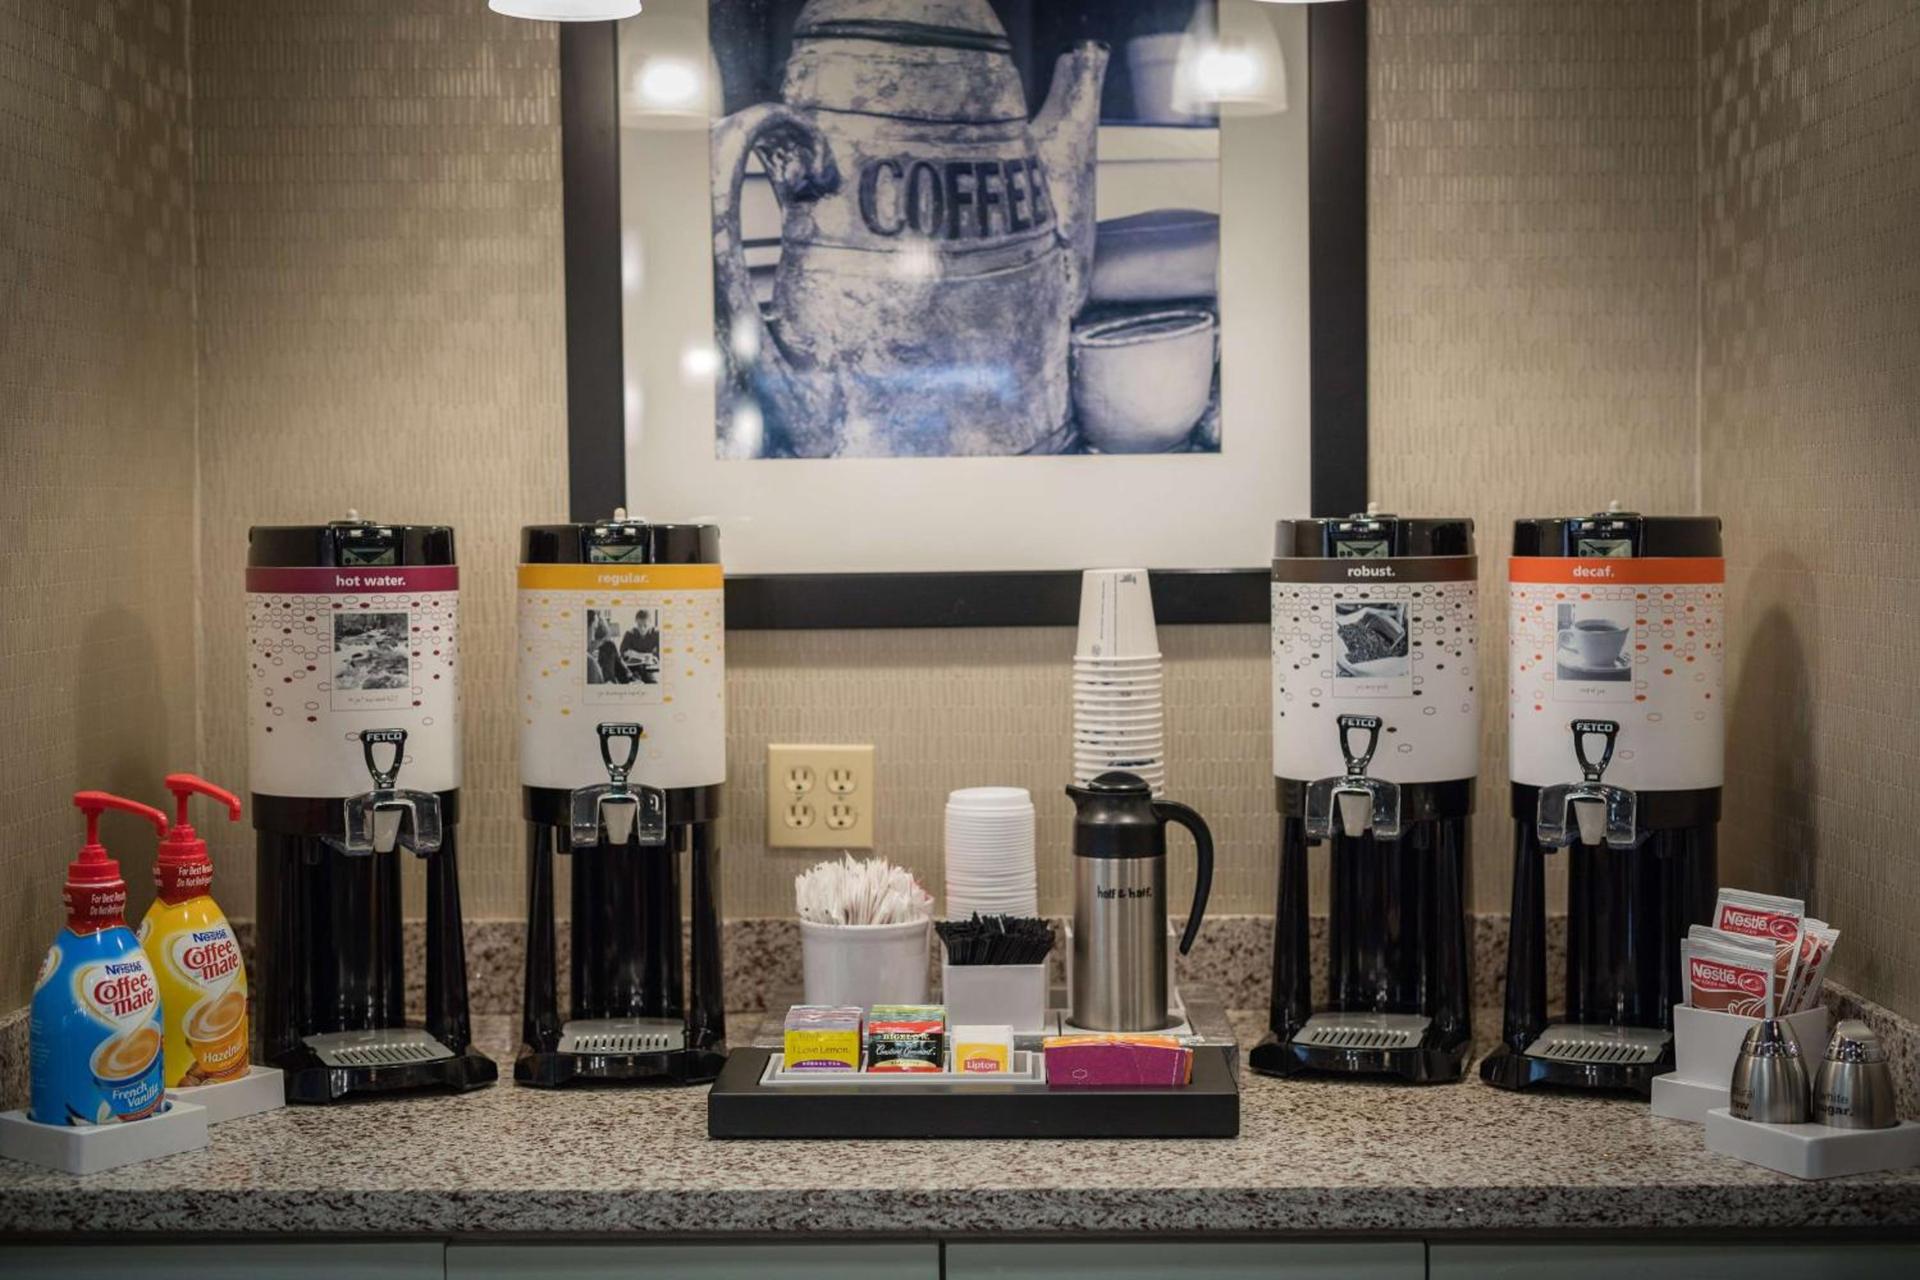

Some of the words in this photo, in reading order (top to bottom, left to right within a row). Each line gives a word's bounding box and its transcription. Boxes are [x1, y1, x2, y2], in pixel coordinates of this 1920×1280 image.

[858, 158, 1050, 240] COFFEE
[1347, 565, 1396, 577] robust.
[1573, 565, 1615, 578] decaf.
[336, 574, 360, 587] hot
[363, 575, 406, 587] water.
[598, 572, 650, 587] regular.
[1341, 718, 1377, 728] FETCO
[1576, 723, 1613, 732] FETCO
[366, 731, 402, 742] FETCO
[602, 726, 637, 735] FETCO
[1097, 885, 1116, 899] half
[201, 952, 240, 981] mate
[113, 988, 154, 1016] mate
[967, 1060, 998, 1071] Lipton
[112, 1081, 147, 1100] French
